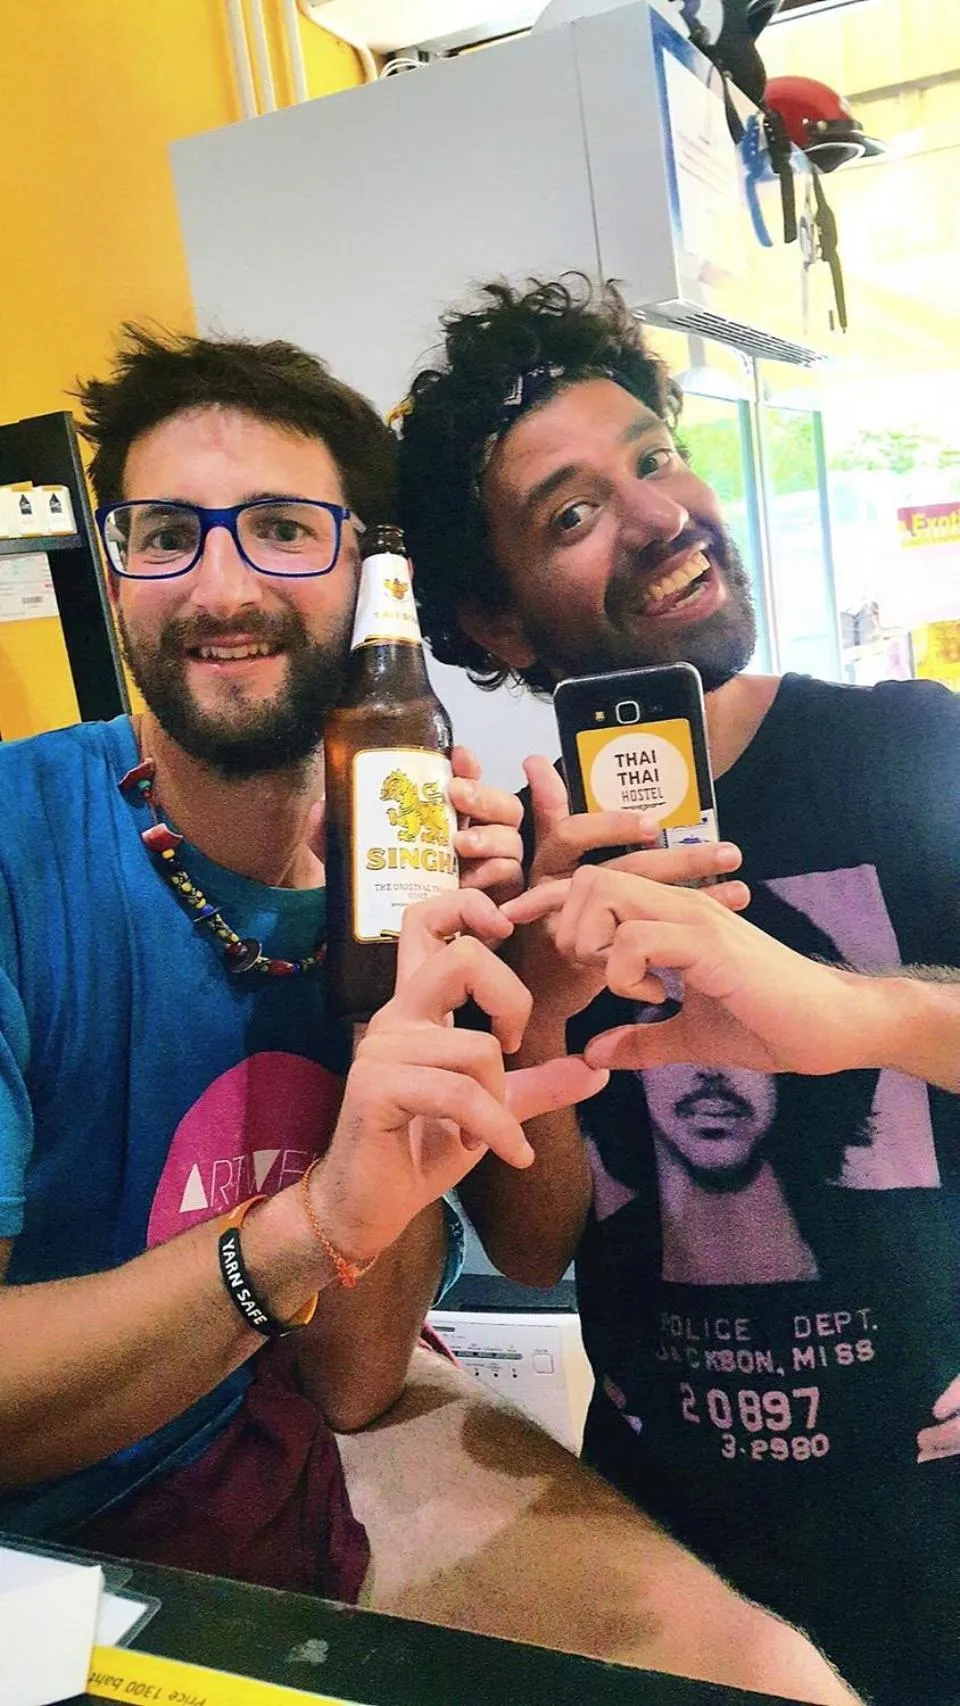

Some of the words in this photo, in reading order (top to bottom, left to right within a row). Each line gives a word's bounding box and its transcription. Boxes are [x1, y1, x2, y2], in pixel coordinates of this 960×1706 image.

[614, 750, 657, 769] THAI
[617, 769, 660, 787] THAI
[621, 787, 665, 803] HOSTEL
[222, 1237, 244, 1289] YARN
[236, 1289, 268, 1326] SAFE
[793, 1308, 878, 1339] DEPT.
[680, 1382, 820, 1432] 20897
[88, 1672, 125, 1691] baht
[124, 1681, 163, 1701] 1300
